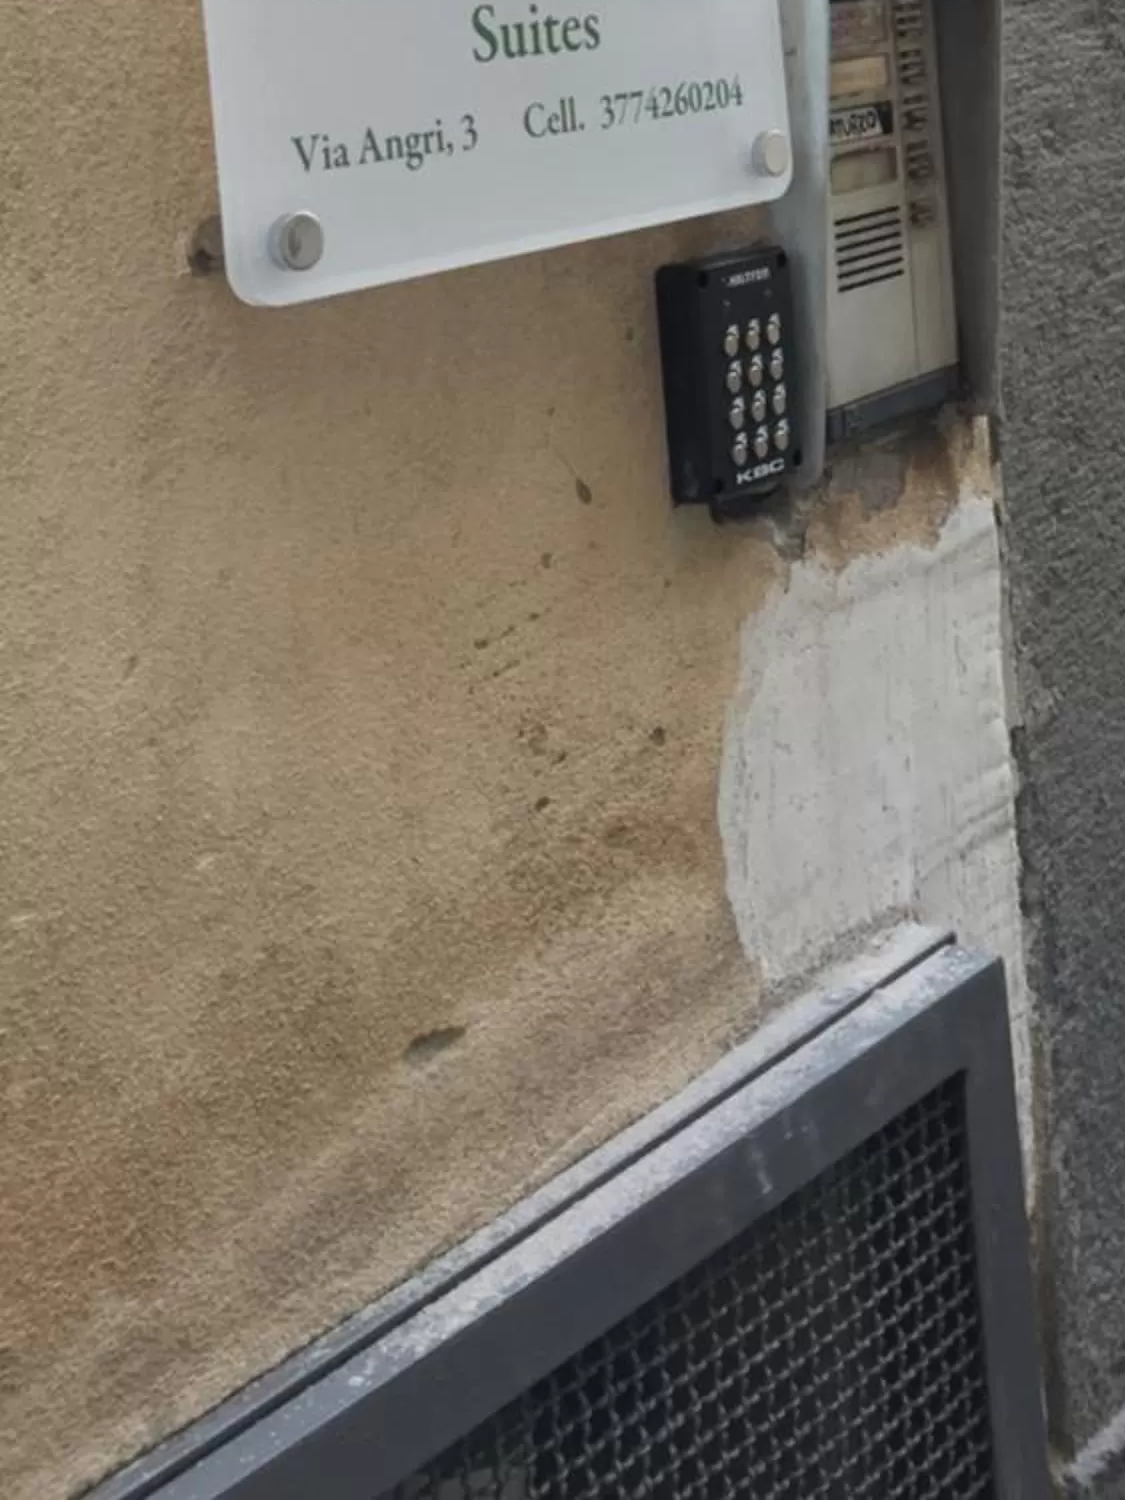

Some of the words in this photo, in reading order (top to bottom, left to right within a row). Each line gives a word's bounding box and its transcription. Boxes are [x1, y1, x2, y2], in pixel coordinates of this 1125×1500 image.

[471, 4, 601, 63] Suites
[522, 98, 586, 140] Cell.
[600, 74, 744, 131] 3774260204
[292, 135, 350, 173] Via
[358, 117, 455, 171] Angri,
[461, 114, 479, 151] 3
